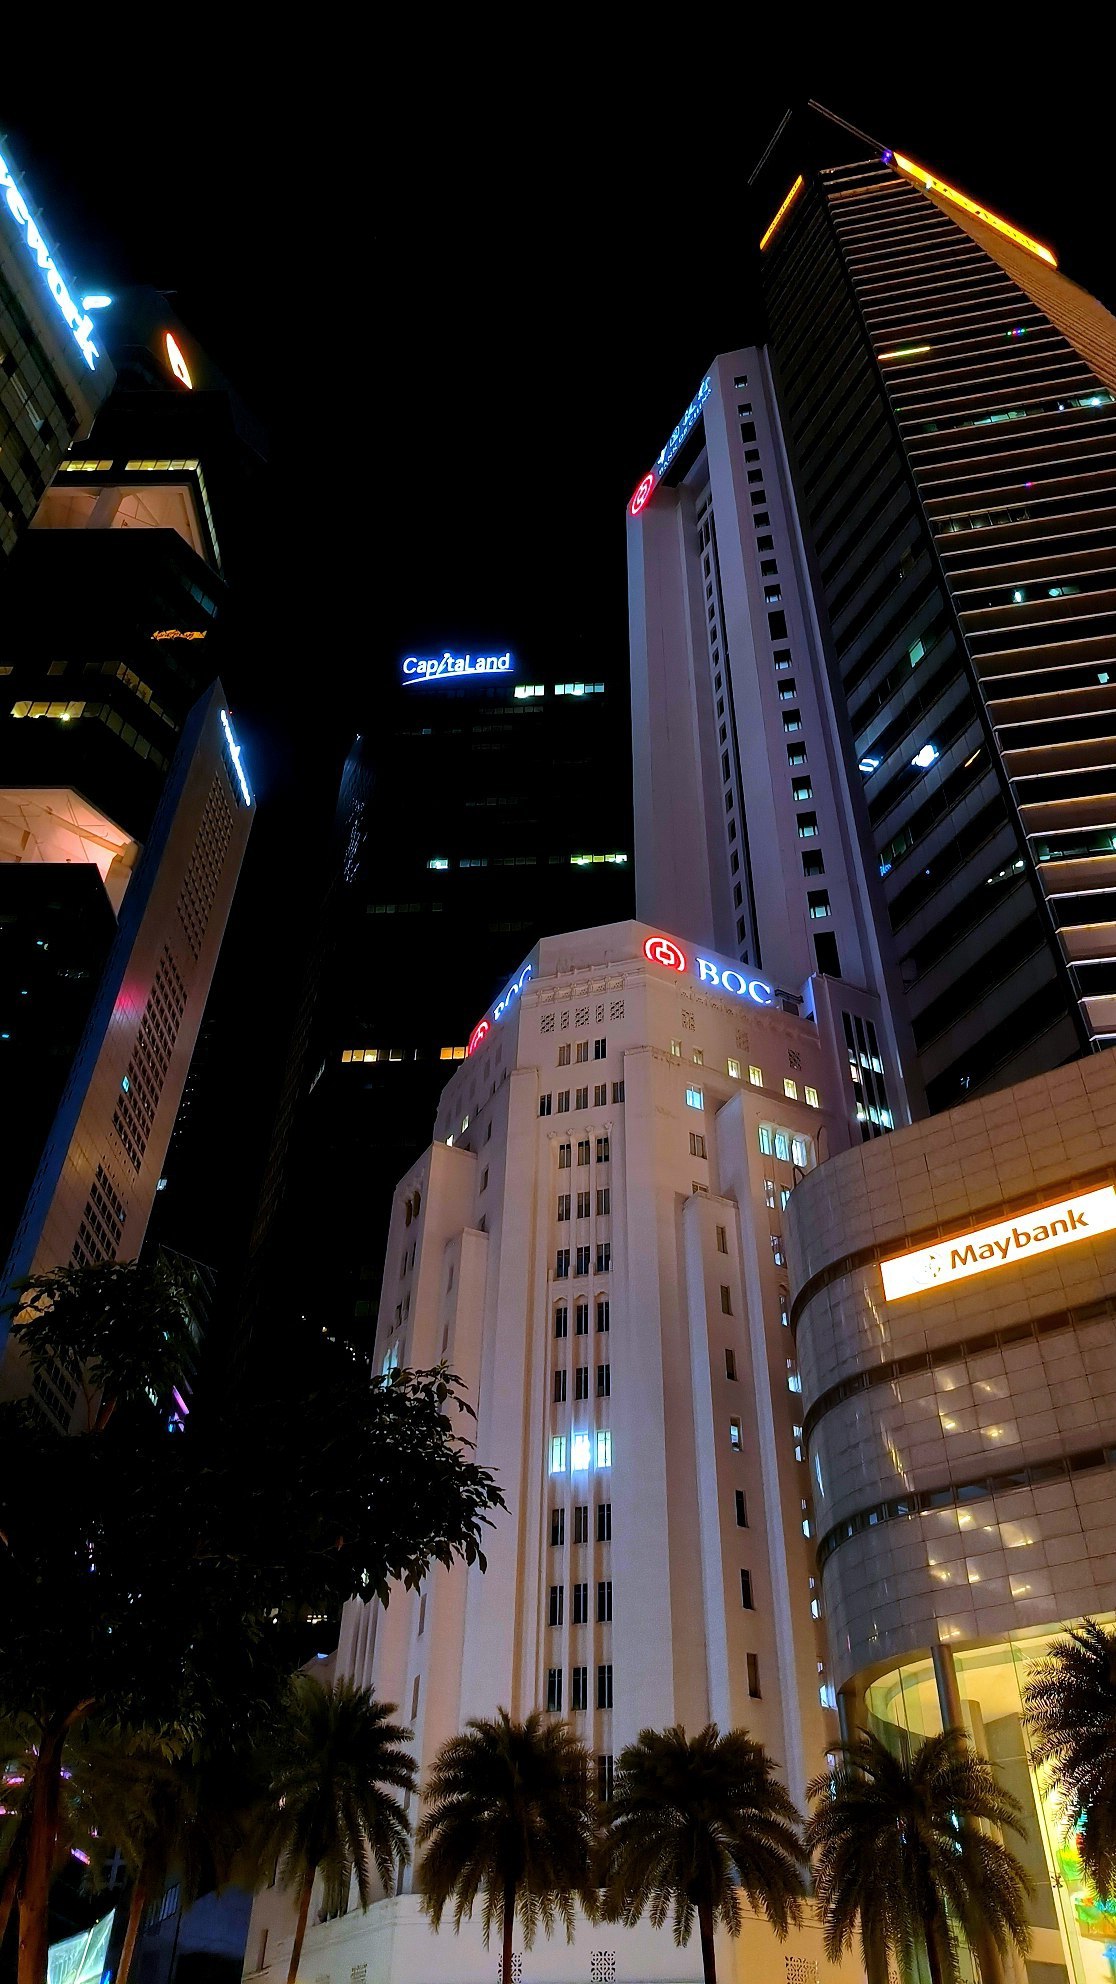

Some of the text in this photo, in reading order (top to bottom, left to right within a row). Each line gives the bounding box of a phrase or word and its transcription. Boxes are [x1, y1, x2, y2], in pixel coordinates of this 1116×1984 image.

[402, 652, 512, 681] CapitaLand
[696, 957, 772, 1005] BOC
[950, 1209, 1089, 1270] Maybank
